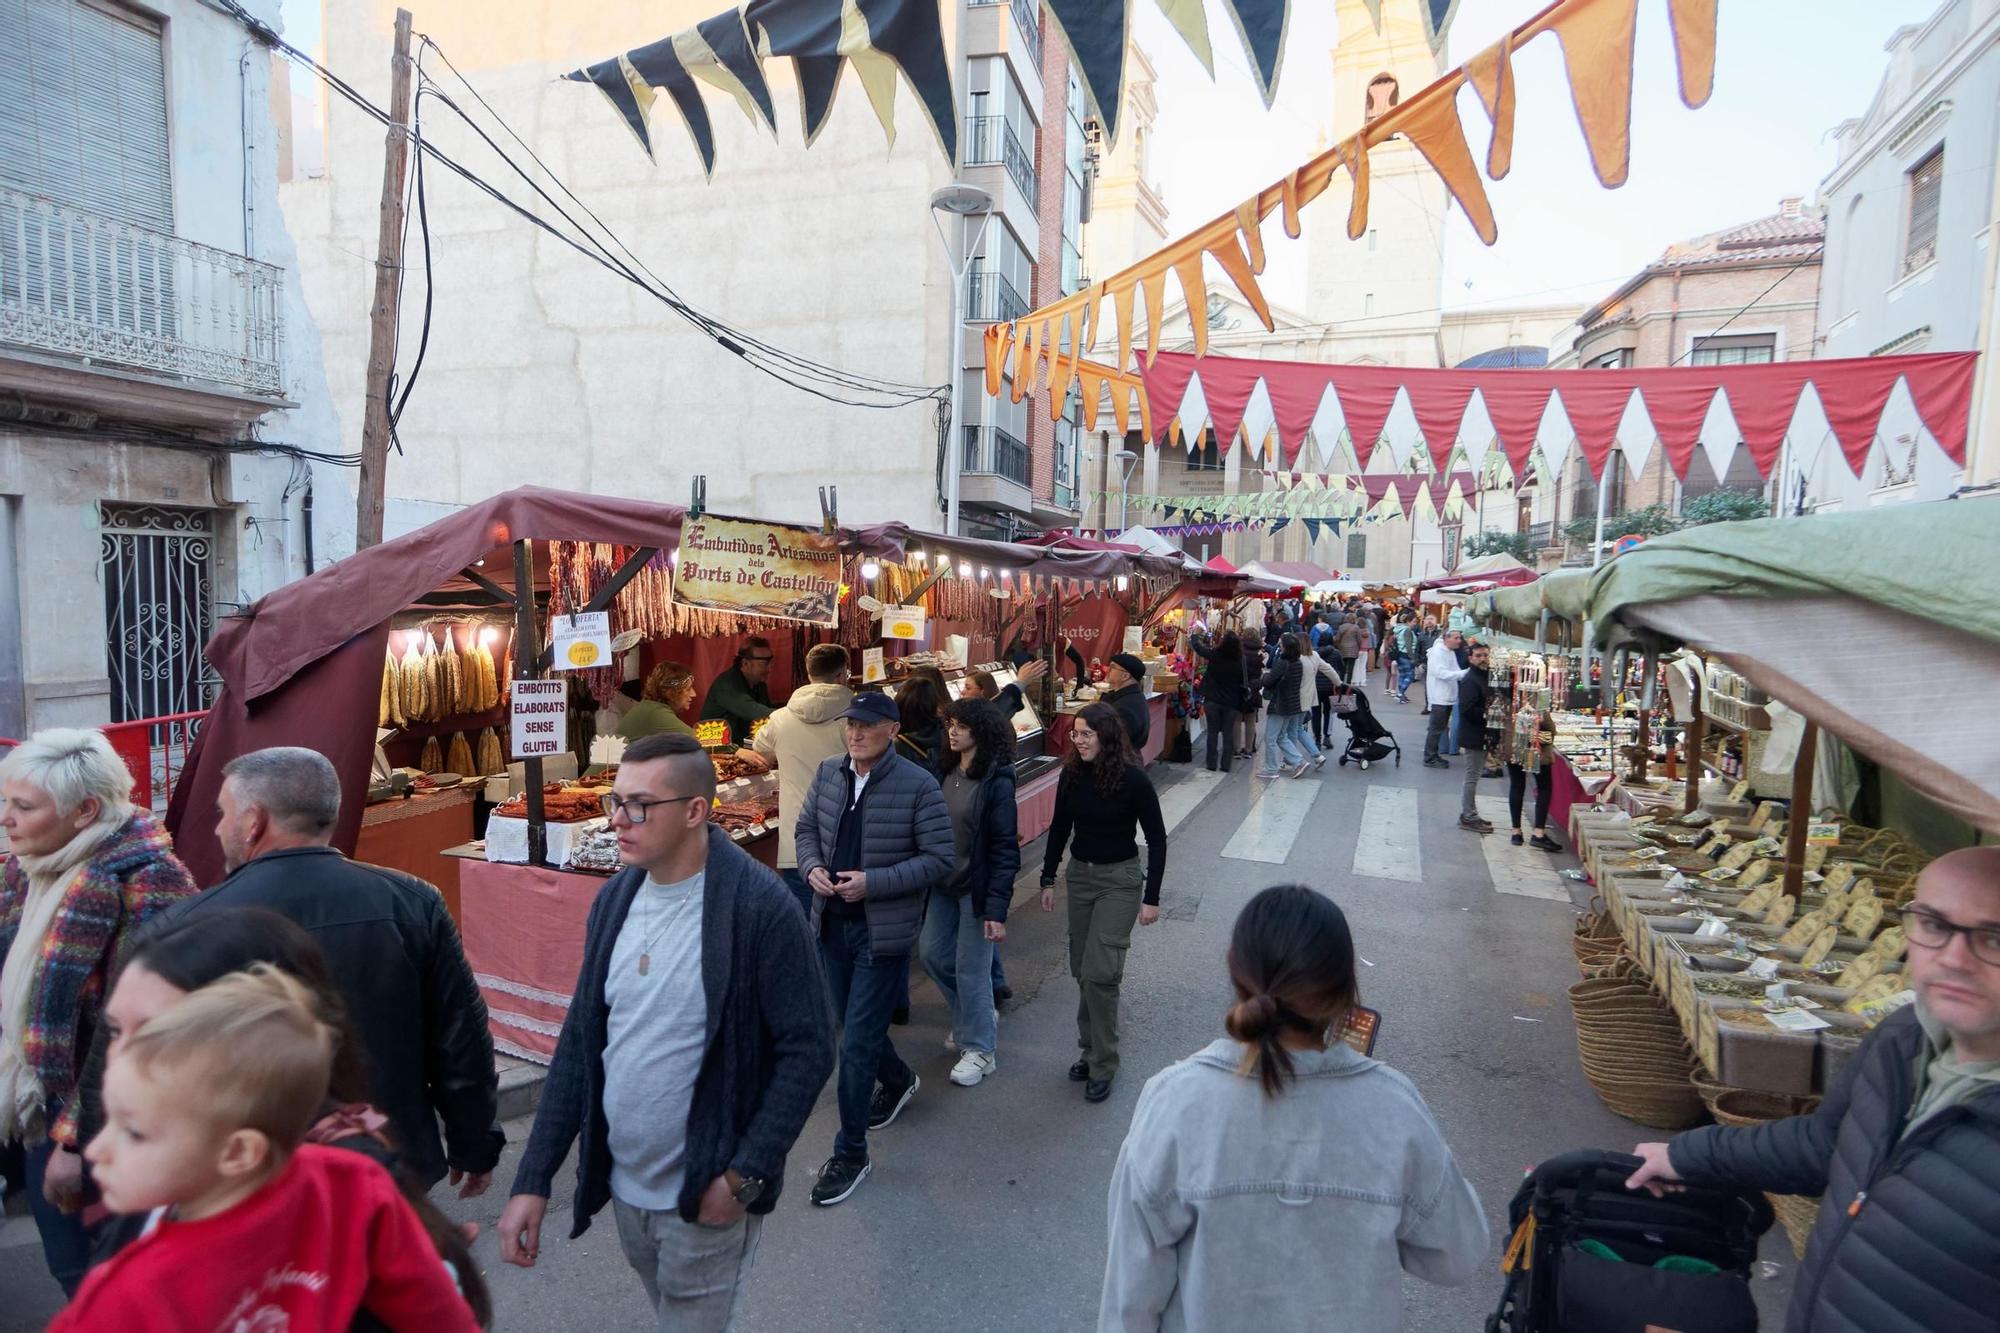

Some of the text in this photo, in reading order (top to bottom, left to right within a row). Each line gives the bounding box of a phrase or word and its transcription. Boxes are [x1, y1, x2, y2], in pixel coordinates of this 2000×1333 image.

[687, 524, 838, 562] Embutidos Artesanos
[748, 558, 765, 568] dels
[681, 561, 838, 594] Ports de Castellón
[518, 683, 562, 694] EMBOTITS
[514, 702, 565, 714] ELABORATS
[525, 721, 554, 733] SENSE
[522, 741, 557, 753] GLUTEN
